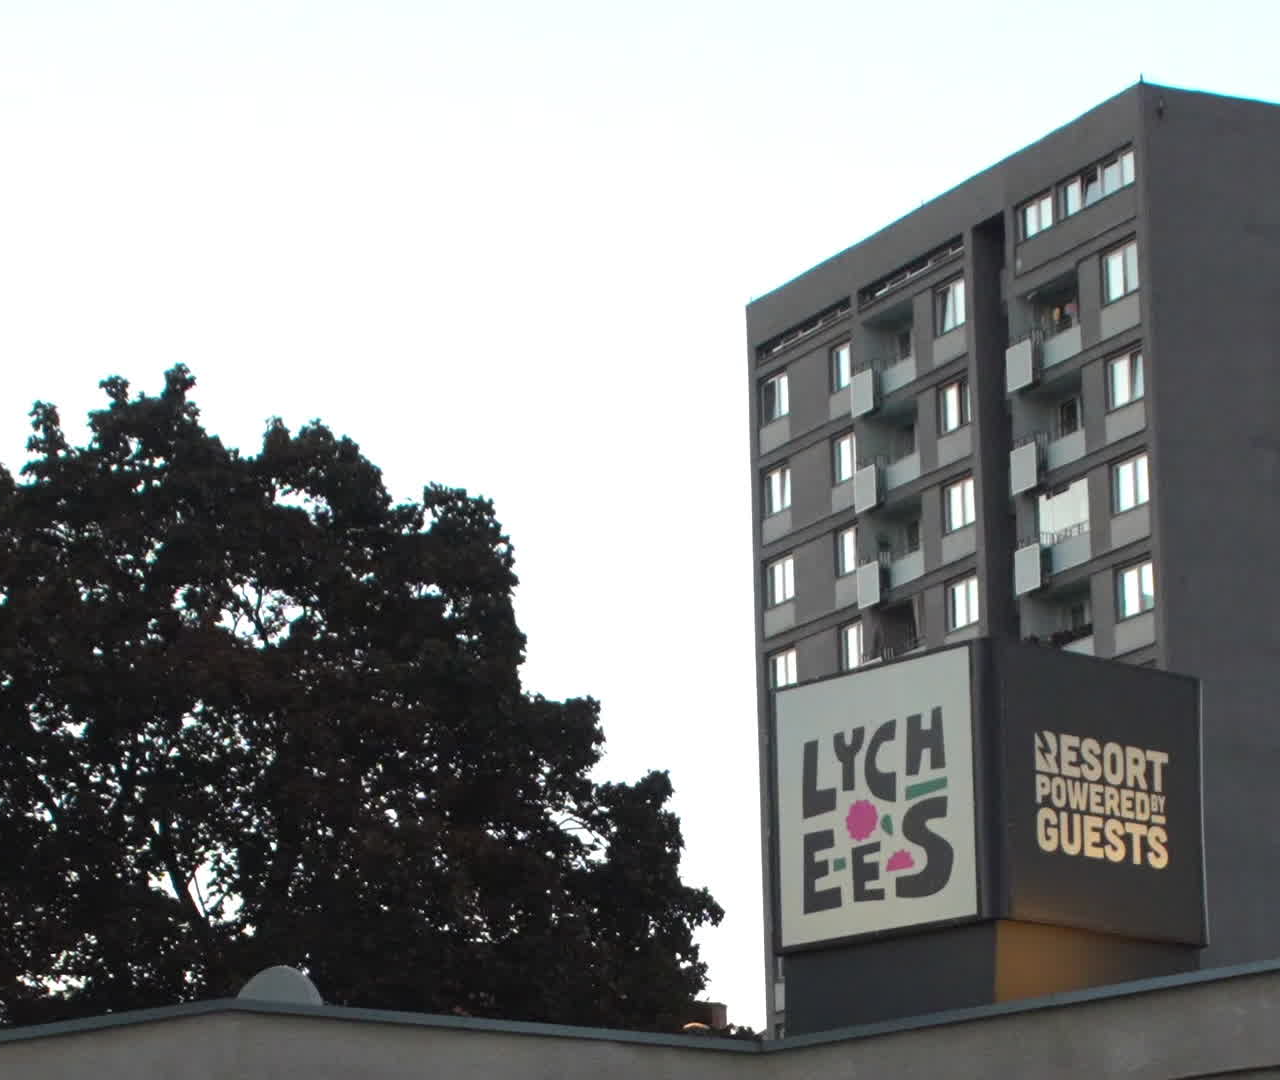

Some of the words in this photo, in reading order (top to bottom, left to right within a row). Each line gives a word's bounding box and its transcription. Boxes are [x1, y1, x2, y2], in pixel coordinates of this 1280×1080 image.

[1034, 730, 1169, 793] RESORT
[1035, 773, 1151, 832] POWERED
[1151, 793, 1167, 815] BY
[1036, 807, 1170, 870] GUESTS
